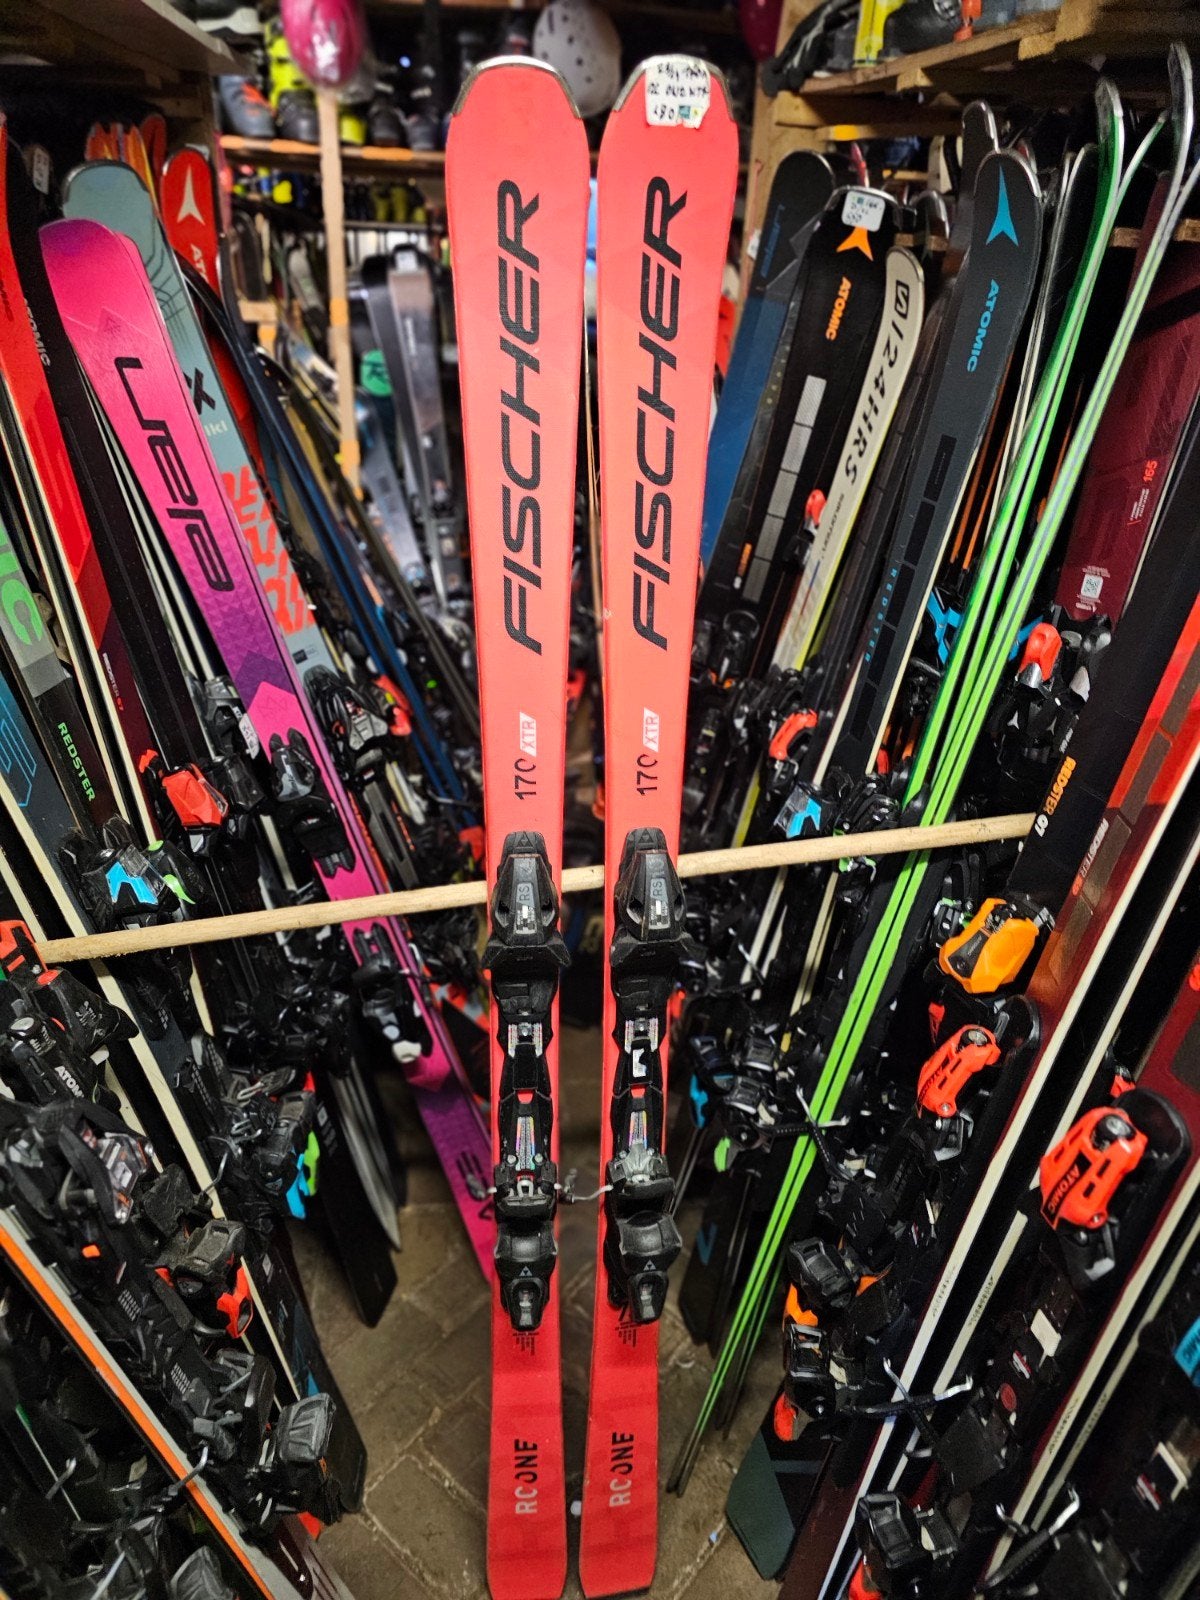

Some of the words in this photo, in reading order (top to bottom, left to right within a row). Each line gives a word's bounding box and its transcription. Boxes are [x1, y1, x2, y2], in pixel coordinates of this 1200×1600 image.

[826, 276, 851, 340] ATOMIC
[967, 279, 999, 372] ATOMIC
[497, 180, 542, 656] FISCHER
[633, 176, 687, 651] FISCHER
[114, 357, 235, 591] elan
[865, 568, 898, 662] REDSTER
[521, 717, 536, 752] XTR
[643, 713, 658, 747] XTR
[58, 722, 96, 801] REDSTER
[515, 758, 537, 800] 170
[636, 753, 658, 796] 170
[1043, 756, 1077, 816] REDSTER
[519, 884, 531, 902] RS
[652, 880, 663, 898] RS
[54, 1065, 85, 1098] ATOM
[1047, 1164, 1082, 1214] ATOMIC
